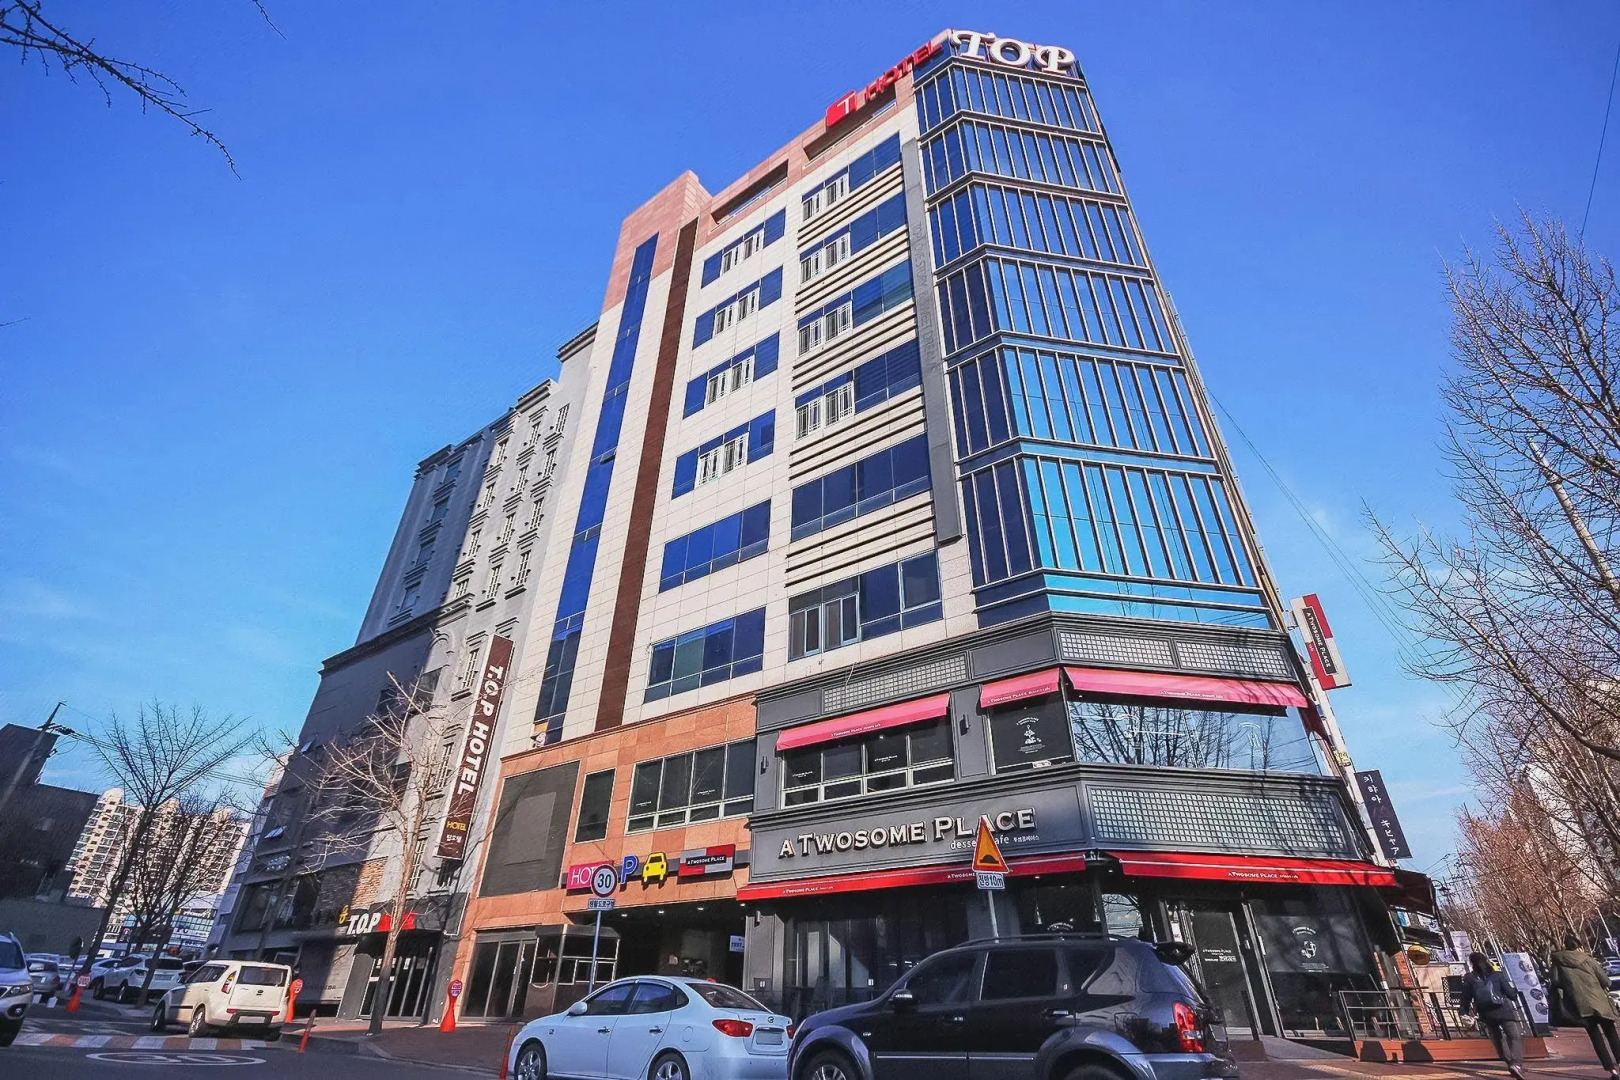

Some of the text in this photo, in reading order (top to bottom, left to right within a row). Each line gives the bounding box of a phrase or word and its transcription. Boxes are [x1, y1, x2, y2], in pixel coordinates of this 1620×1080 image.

[951, 30, 1075, 75] TOP
[864, 40, 943, 101] HOTEL
[457, 721, 490, 795] HOTEL
[446, 820, 467, 832] HOTEL
[778, 806, 1038, 859] A TWOSOME PLACE
[950, 839, 978, 850] desse
[994, 834, 1010, 845] afe
[596, 873, 612, 888] 30
[346, 912, 382, 935] T.O.P
